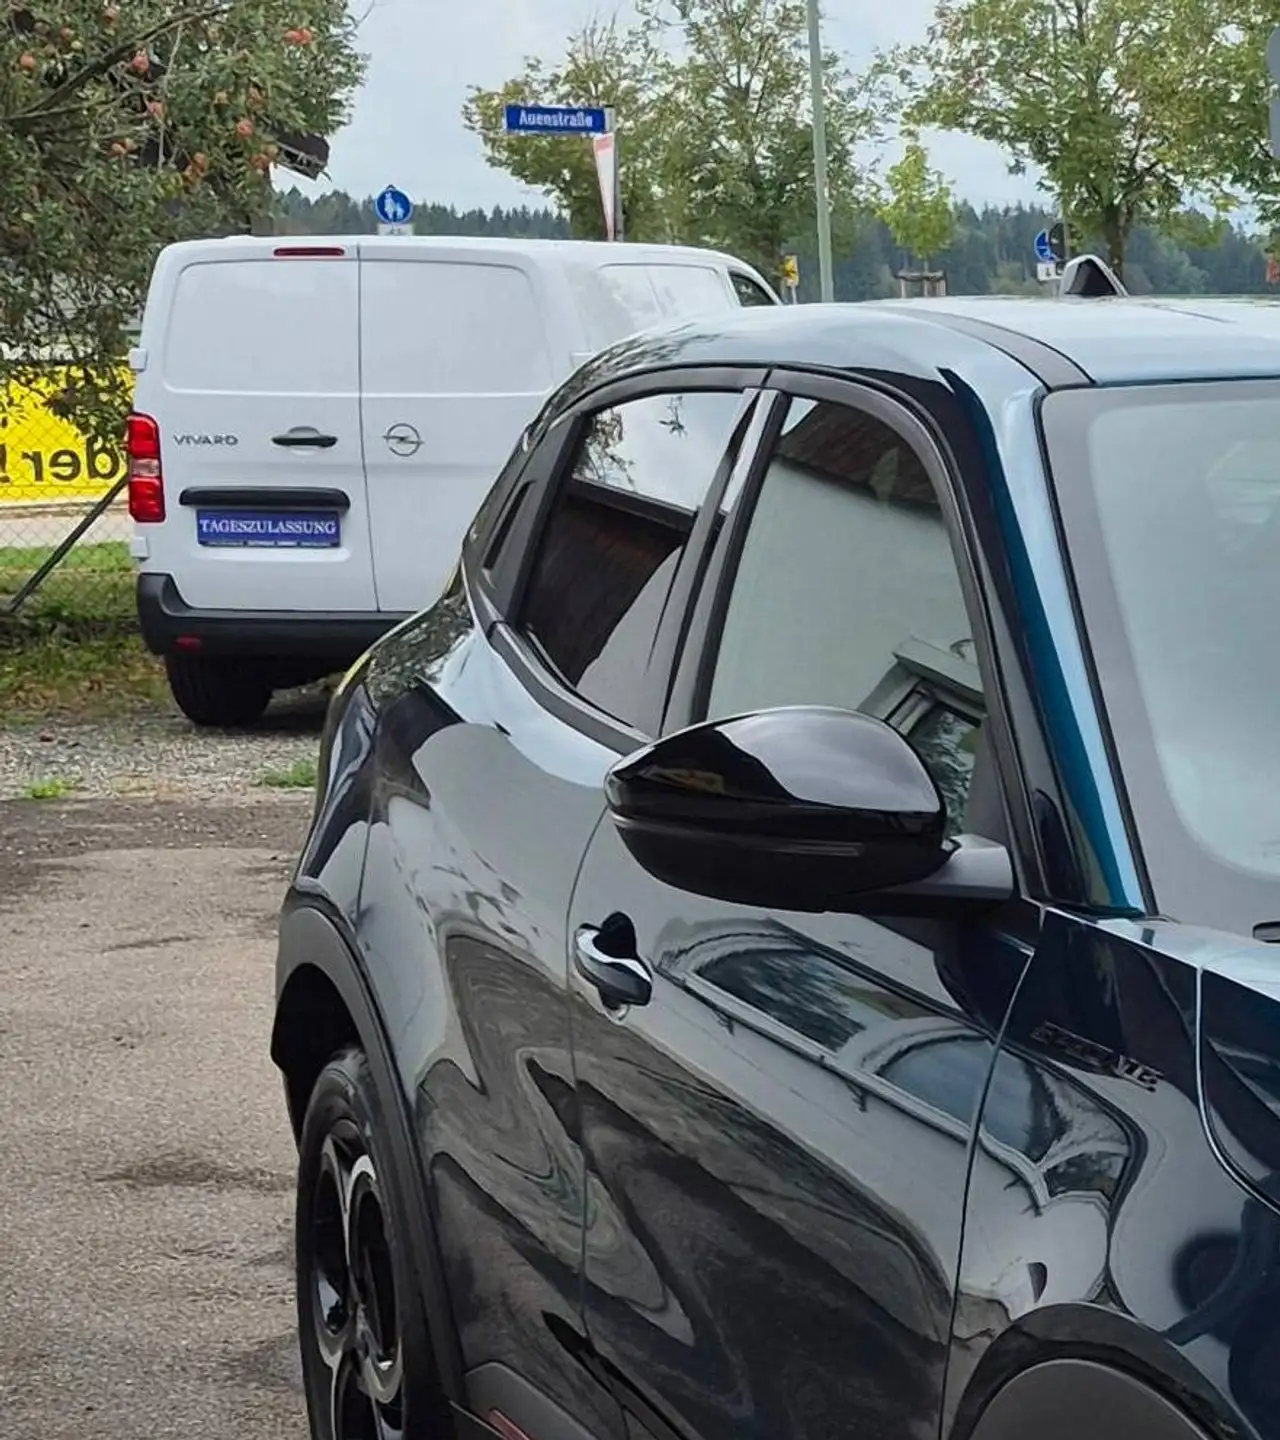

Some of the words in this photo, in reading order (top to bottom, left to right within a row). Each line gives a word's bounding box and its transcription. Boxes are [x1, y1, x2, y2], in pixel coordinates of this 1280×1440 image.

[519, 109, 593, 128] Auenstraße
[173, 434, 239, 446] VIVARO
[199, 518, 337, 535] TAGESZULASSUNG
